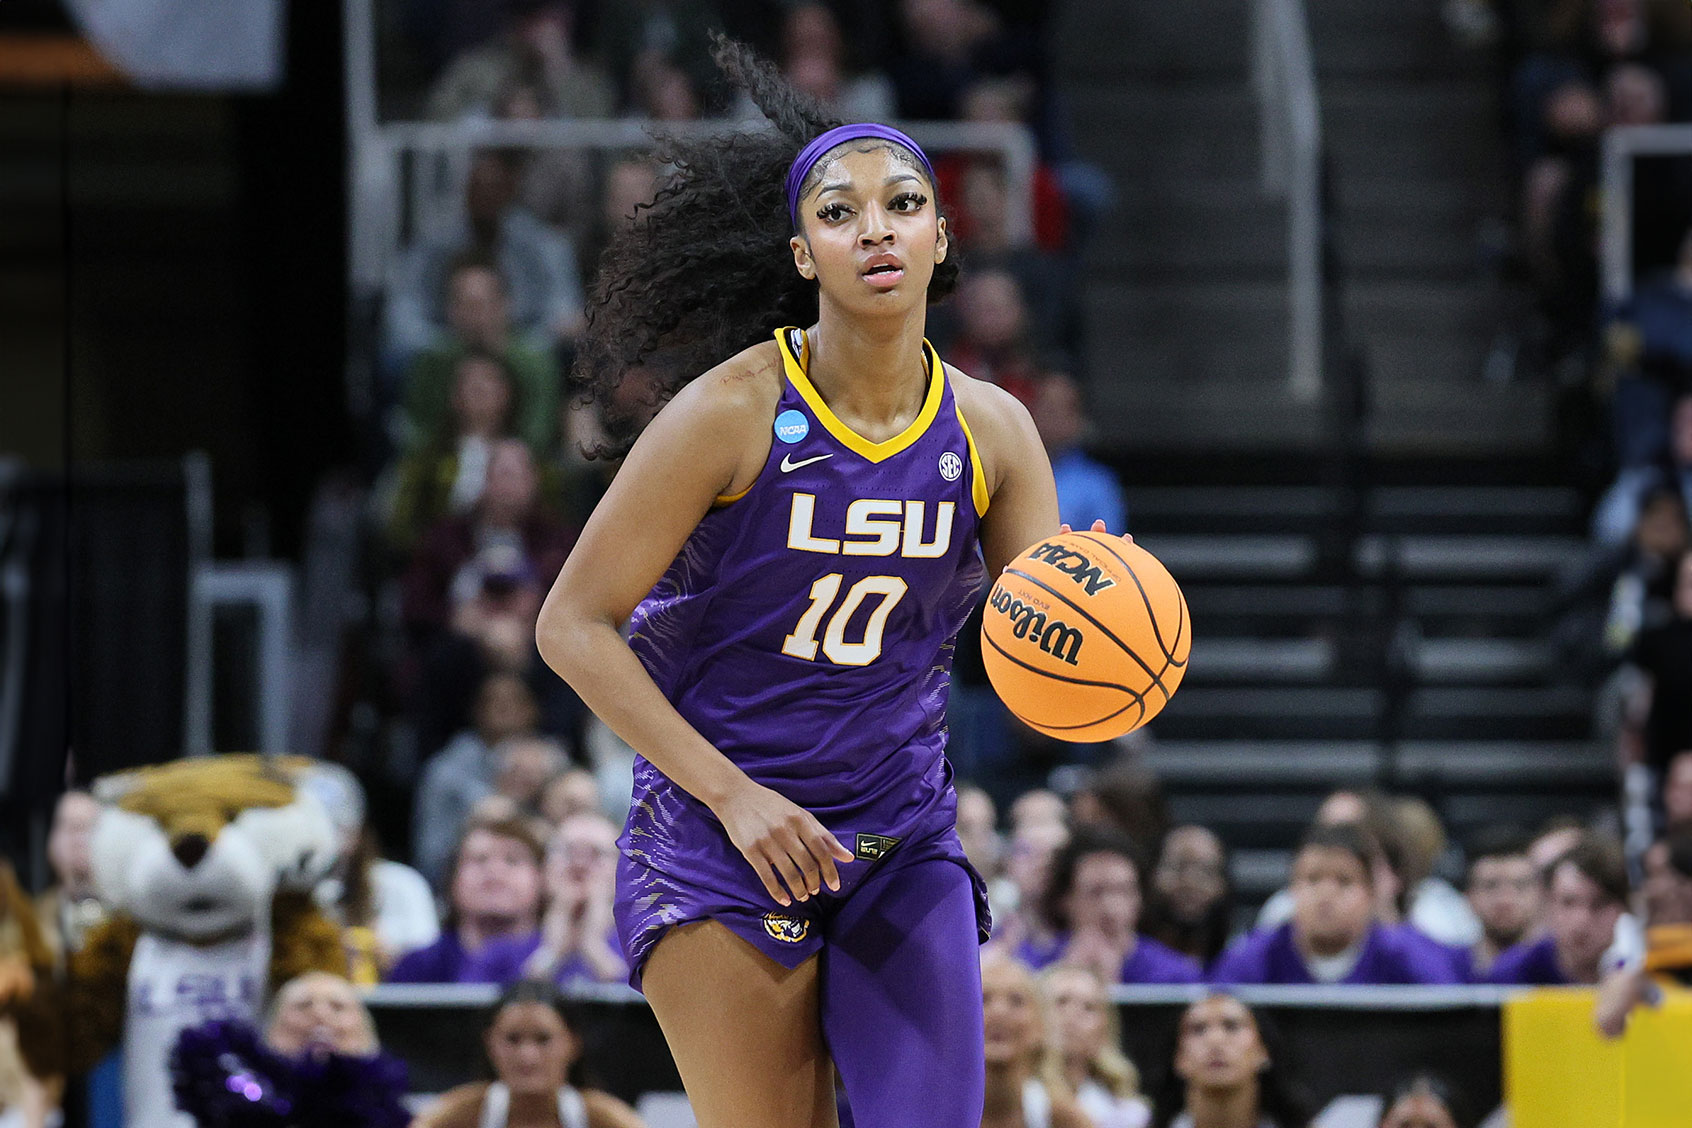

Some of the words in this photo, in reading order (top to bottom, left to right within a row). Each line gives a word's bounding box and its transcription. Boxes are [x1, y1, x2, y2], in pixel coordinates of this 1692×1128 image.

[779, 424, 807, 436] NCAA
[941, 454, 960, 478] SEC
[787, 492, 955, 558] LSU
[1029, 542, 1116, 597] NCAA
[781, 573, 908, 666] 10
[990, 583, 1084, 666] Wilson
